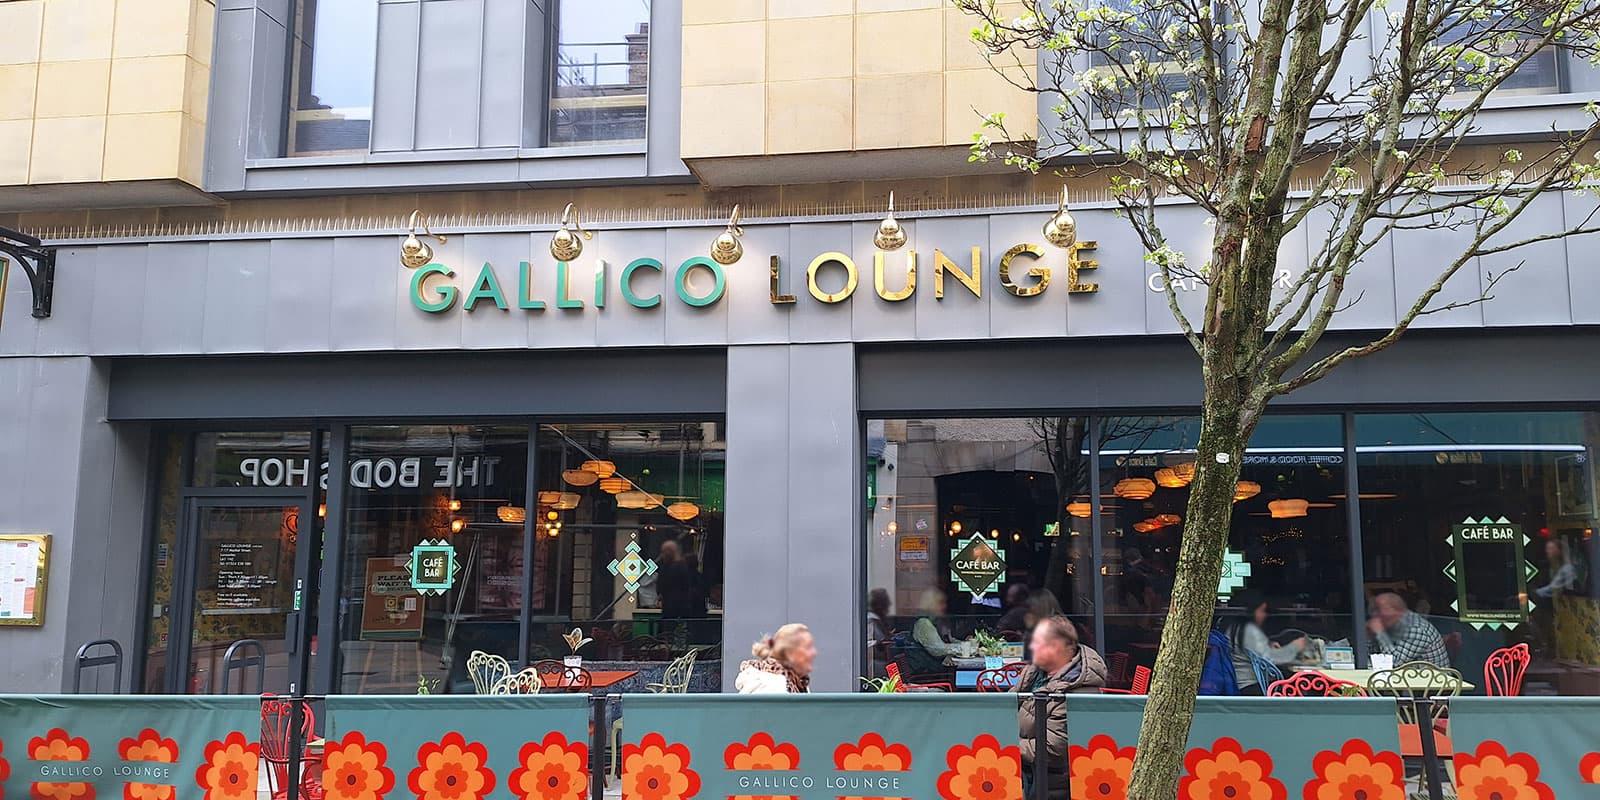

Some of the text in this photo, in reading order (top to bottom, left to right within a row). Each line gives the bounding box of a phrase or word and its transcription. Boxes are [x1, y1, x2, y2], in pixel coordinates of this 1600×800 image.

[409, 241, 1098, 313] GALLICO LOUNGE
[1147, 269, 1211, 293] CAF
[1461, 525, 1514, 540] CAFÉ BAR
[422, 556, 444, 568] CAFÉ
[981, 560, 1000, 570] BAR
[424, 568, 440, 577] BAR
[40, 766, 169, 778] GALLICO LOUNGE
[739, 776, 899, 789] GALLICO LOUNGE
